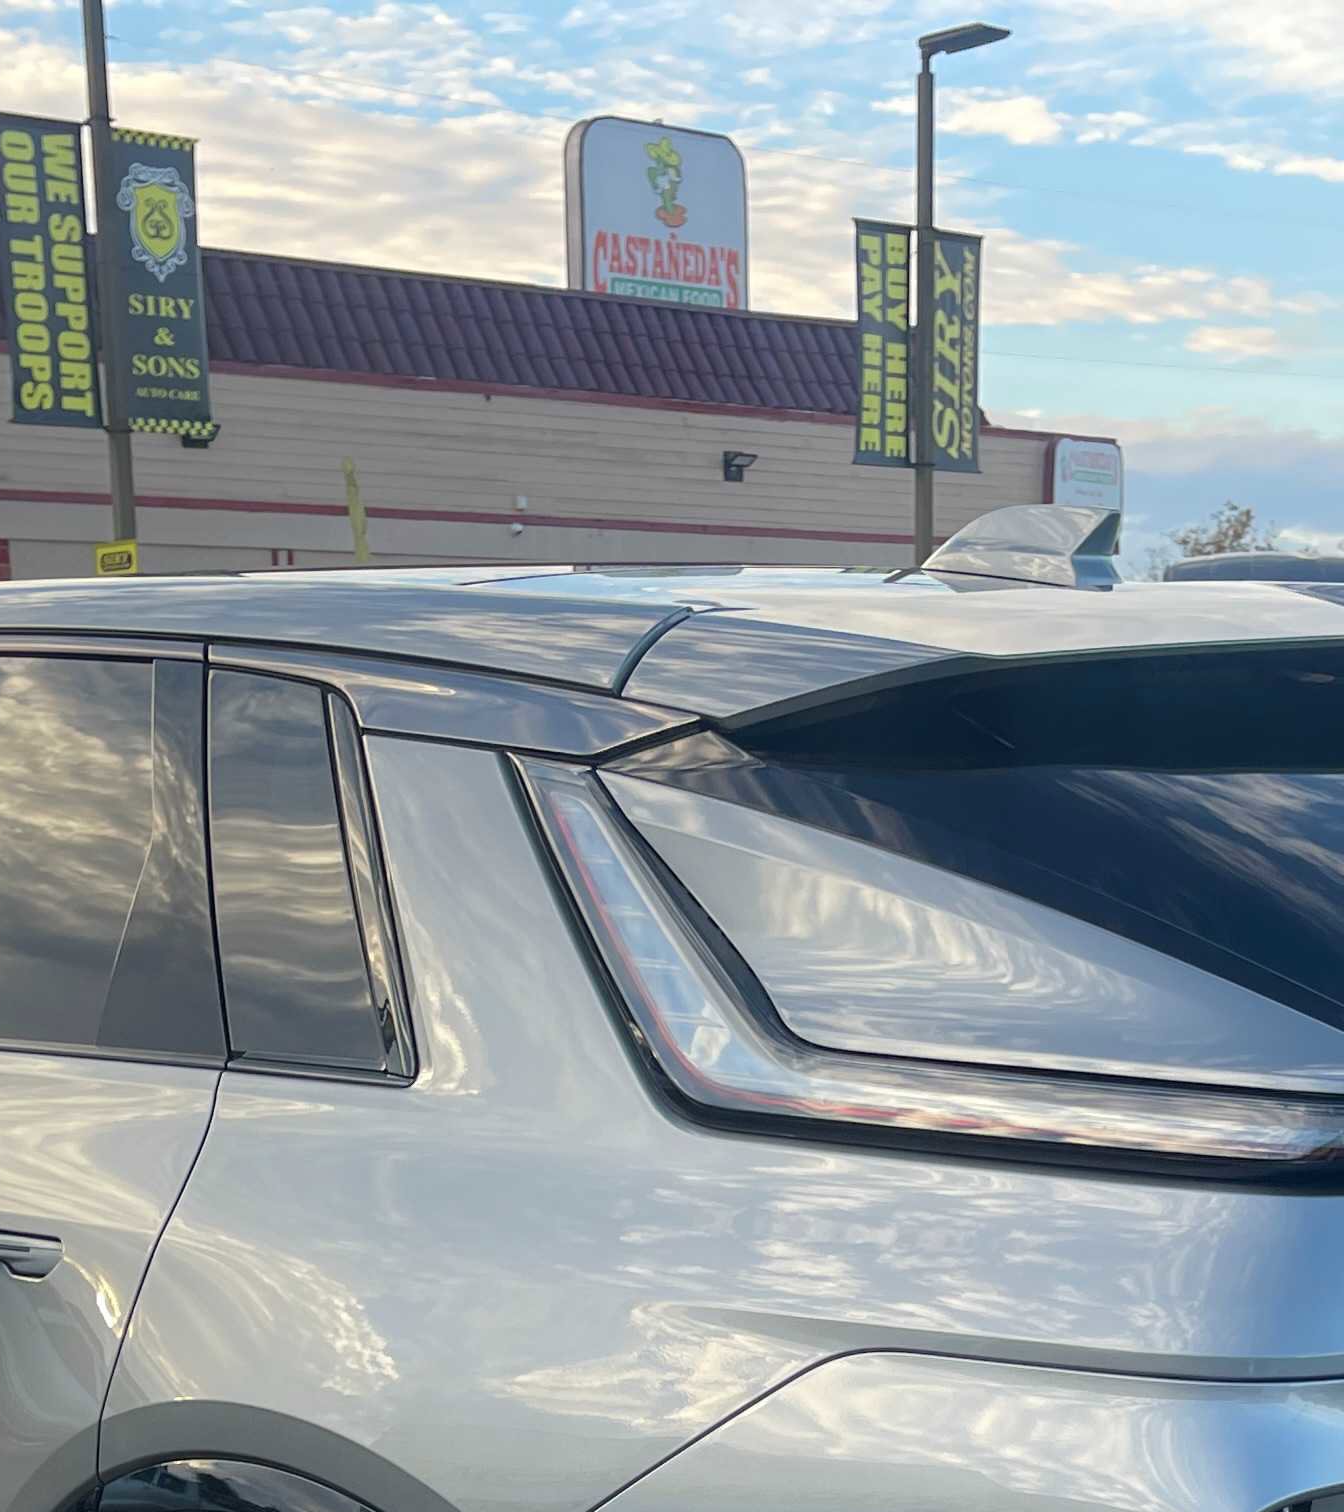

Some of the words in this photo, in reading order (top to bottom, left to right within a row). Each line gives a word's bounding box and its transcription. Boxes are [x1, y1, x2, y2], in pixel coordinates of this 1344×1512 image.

[0, 130, 41, 225] OUR
[41, 133, 80, 205] WE
[9, 234, 54, 411] TROOPS
[48, 215, 94, 417] SUPPORT
[128, 293, 195, 320] SIRY
[859, 233, 883, 322] PAY
[885, 233, 907, 333] BUY
[132, 354, 201, 379] SONS
[154, 327, 175, 346] &
[931, 240, 961, 459] SIRY
[859, 334, 883, 452] HERE
[885, 342, 907, 458] HERE
